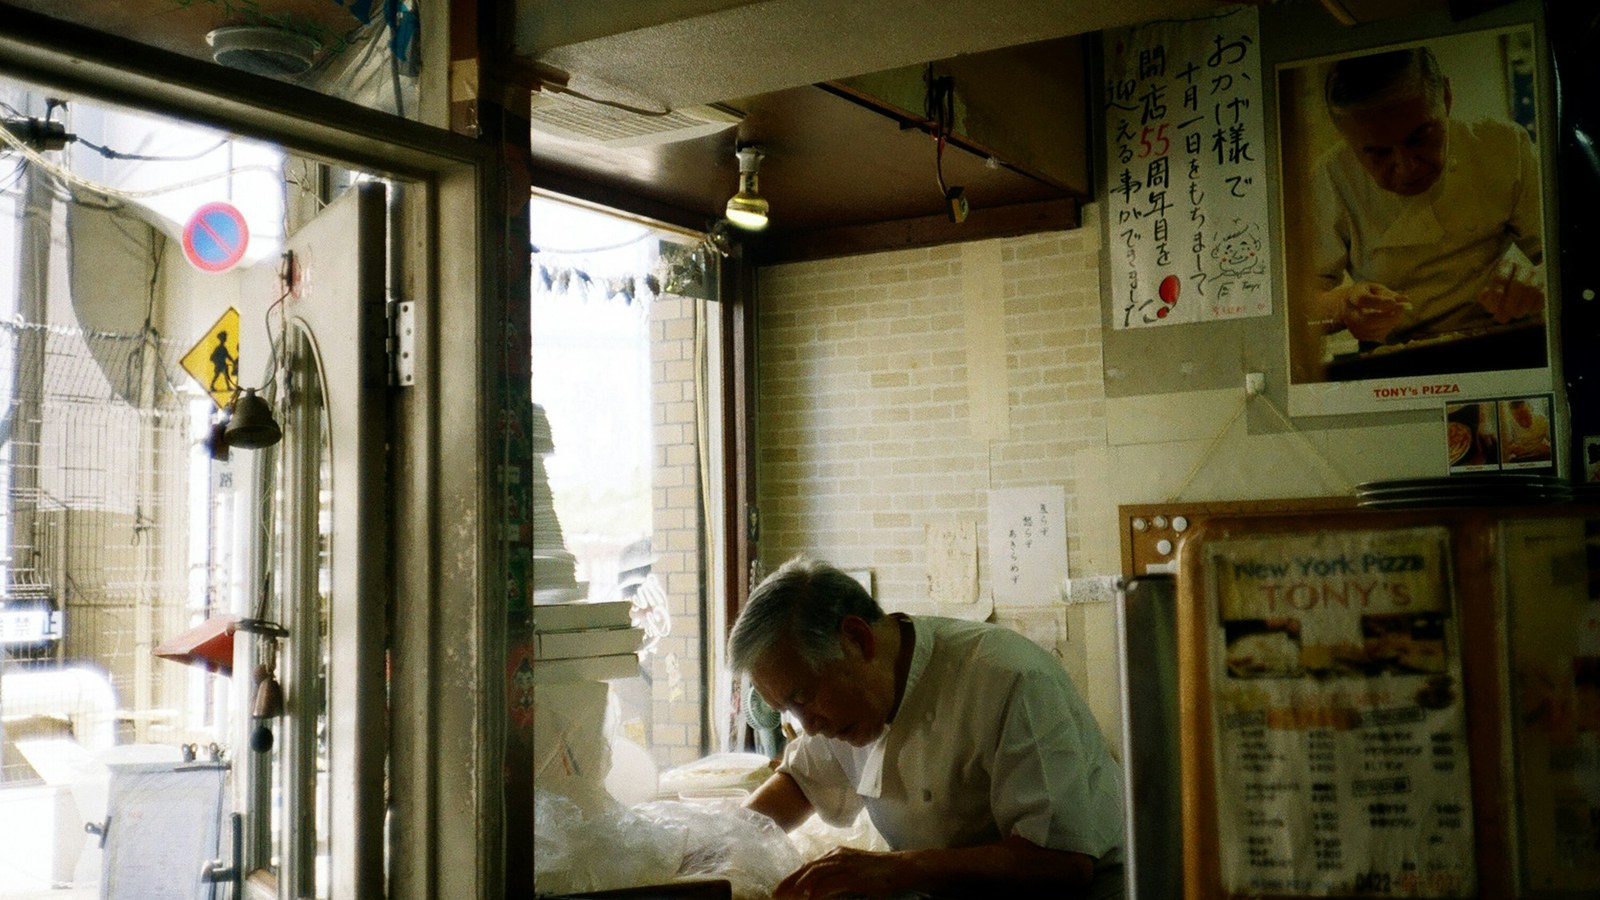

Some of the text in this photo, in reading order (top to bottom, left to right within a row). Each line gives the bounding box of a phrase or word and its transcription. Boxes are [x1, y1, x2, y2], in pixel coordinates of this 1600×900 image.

[1137, 45, 1174, 267] 開店55周年目を
[1206, 34, 1255, 199] おかげ様で
[1175, 61, 1206, 297] 十月一日をもちまして
[1374, 384, 1460, 398] TONY's PIZZA
[1234, 562, 1289, 578] New
[1295, 554, 1350, 576] York
[1260, 580, 1412, 612] TONY'S
